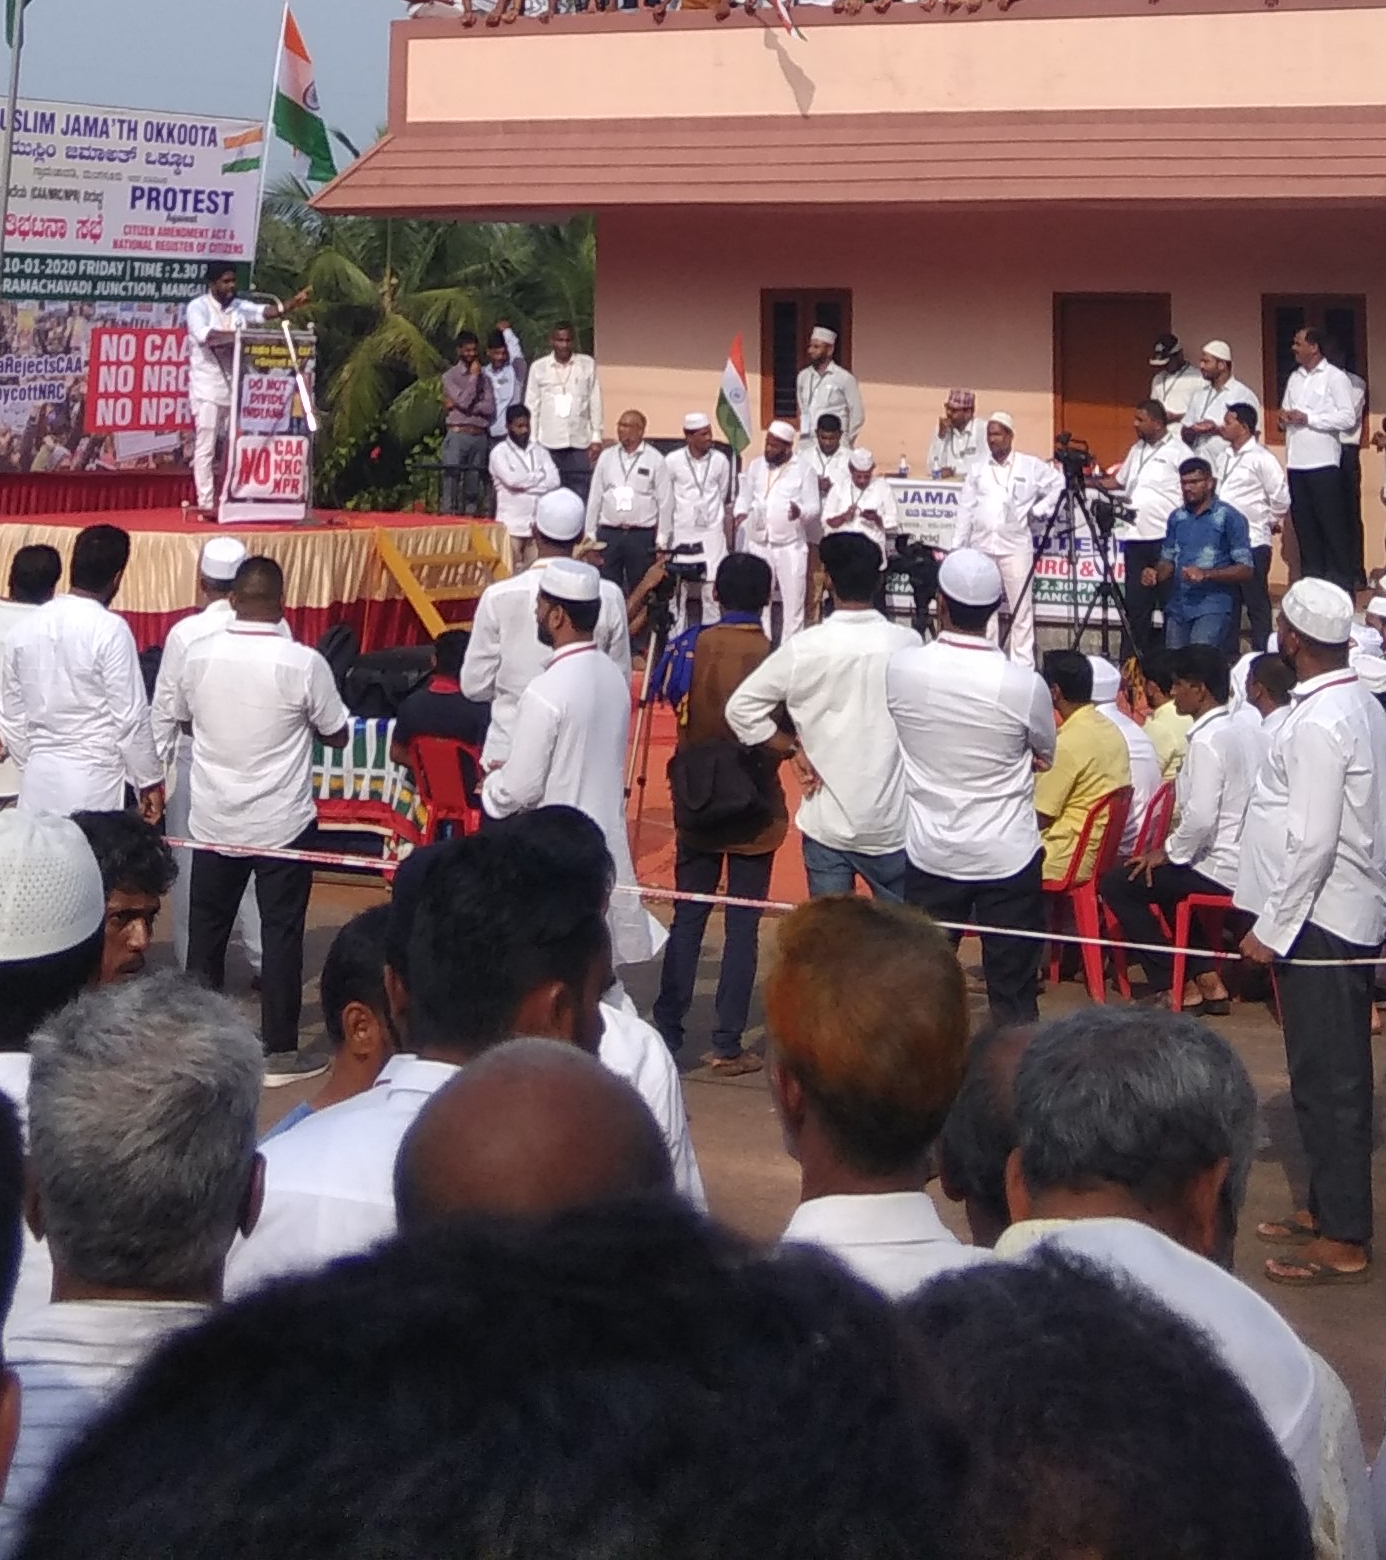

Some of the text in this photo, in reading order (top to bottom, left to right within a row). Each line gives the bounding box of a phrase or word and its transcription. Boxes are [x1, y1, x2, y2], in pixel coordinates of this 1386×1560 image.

[143, 121, 218, 147] OKKOOTA
[130, 185, 234, 215] PROTEST
[3, 258, 77, 275] 10-01-2020
[78, 260, 124, 276] FRIDAY
[134, 262, 163, 278] TIME
[172, 263, 198, 279] 2.30
[3, 278, 92, 295] RAMACHAVADI
[99, 333, 191, 363] NO CAA
[97, 364, 135, 393] NO
[249, 378, 288, 391] DO NOT
[249, 393, 284, 405] DIVIDE
[95, 397, 192, 426] NO NPR
[273, 440, 303, 456] CAA
[239, 447, 271, 486] NO
[273, 458, 302, 475] NRC
[271, 477, 300, 494] NPR
[898, 491, 958, 505] JAMA
